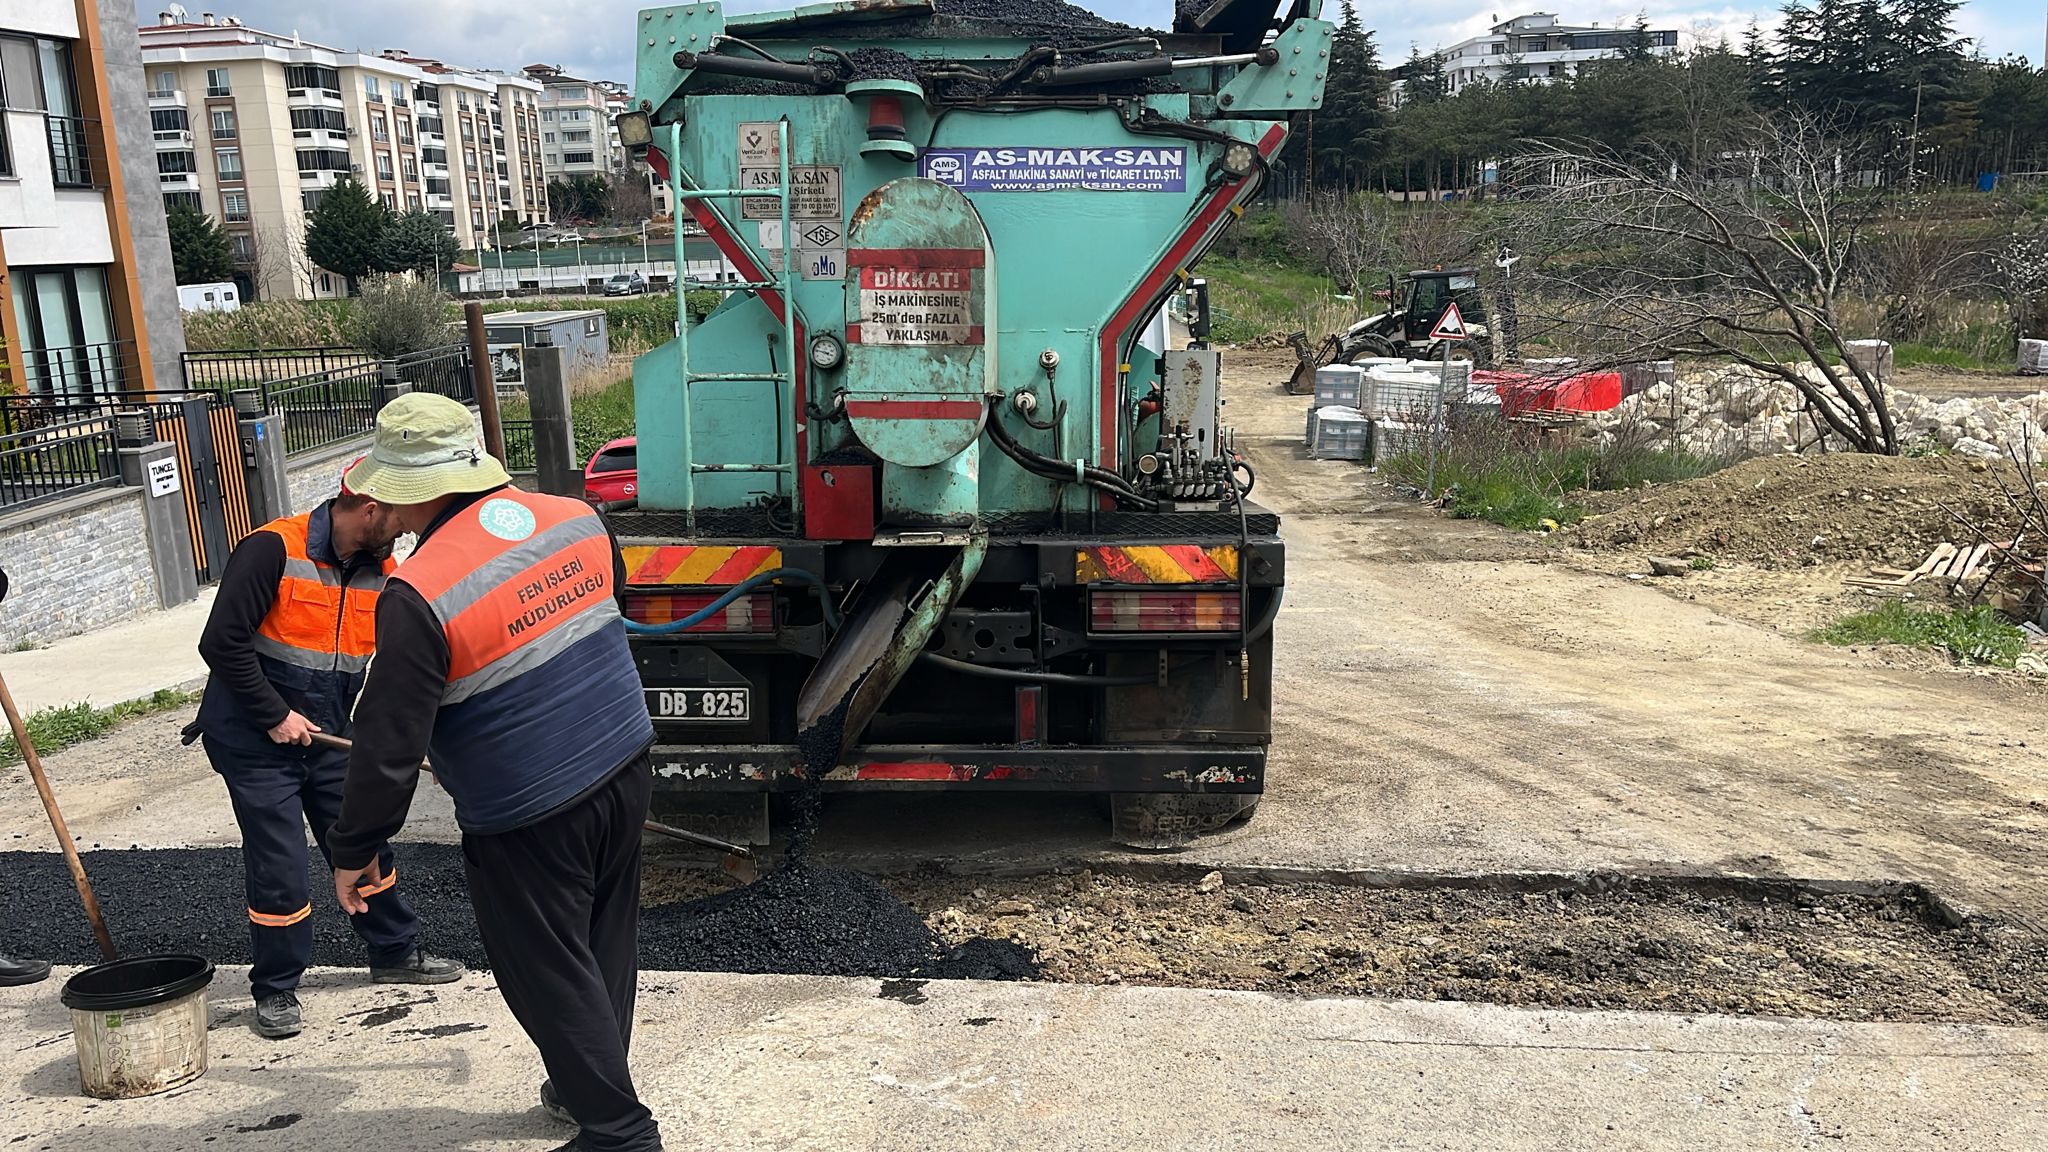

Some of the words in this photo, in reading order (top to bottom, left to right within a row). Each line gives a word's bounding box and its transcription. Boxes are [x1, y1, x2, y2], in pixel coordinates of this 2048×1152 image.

[933, 161, 957, 169] AMS
[971, 150, 1182, 166] AS-MAK-SAN
[752, 171, 829, 185] AS.MK.SAN
[971, 169, 1008, 180] ASFALT
[1009, 167, 1048, 180] MAKİNA
[1049, 167, 1085, 180] SANAYİ
[1086, 171, 1098, 180] ve
[1100, 167, 1141, 180] TİCARET
[794, 186, 825, 197] Şirketi
[990, 181, 1163, 190] www.asmaksan.com
[813, 228, 830, 243] TSE
[874, 266, 960, 289] DİKKAT!
[874, 291, 886, 307] İŞ
[888, 293, 960, 307] MAKİNESİNE
[872, 312, 923, 324] 25m'den
[925, 313, 960, 325] FAZLA
[151, 462, 176, 477] TUNCEL
[516, 580, 544, 604] FEN
[544, 555, 584, 590] İŞLERİ
[507, 573, 604, 637] MÜDÜRLÜĞÜ
[659, 692, 688, 716] DB
[702, 692, 745, 716] 825
